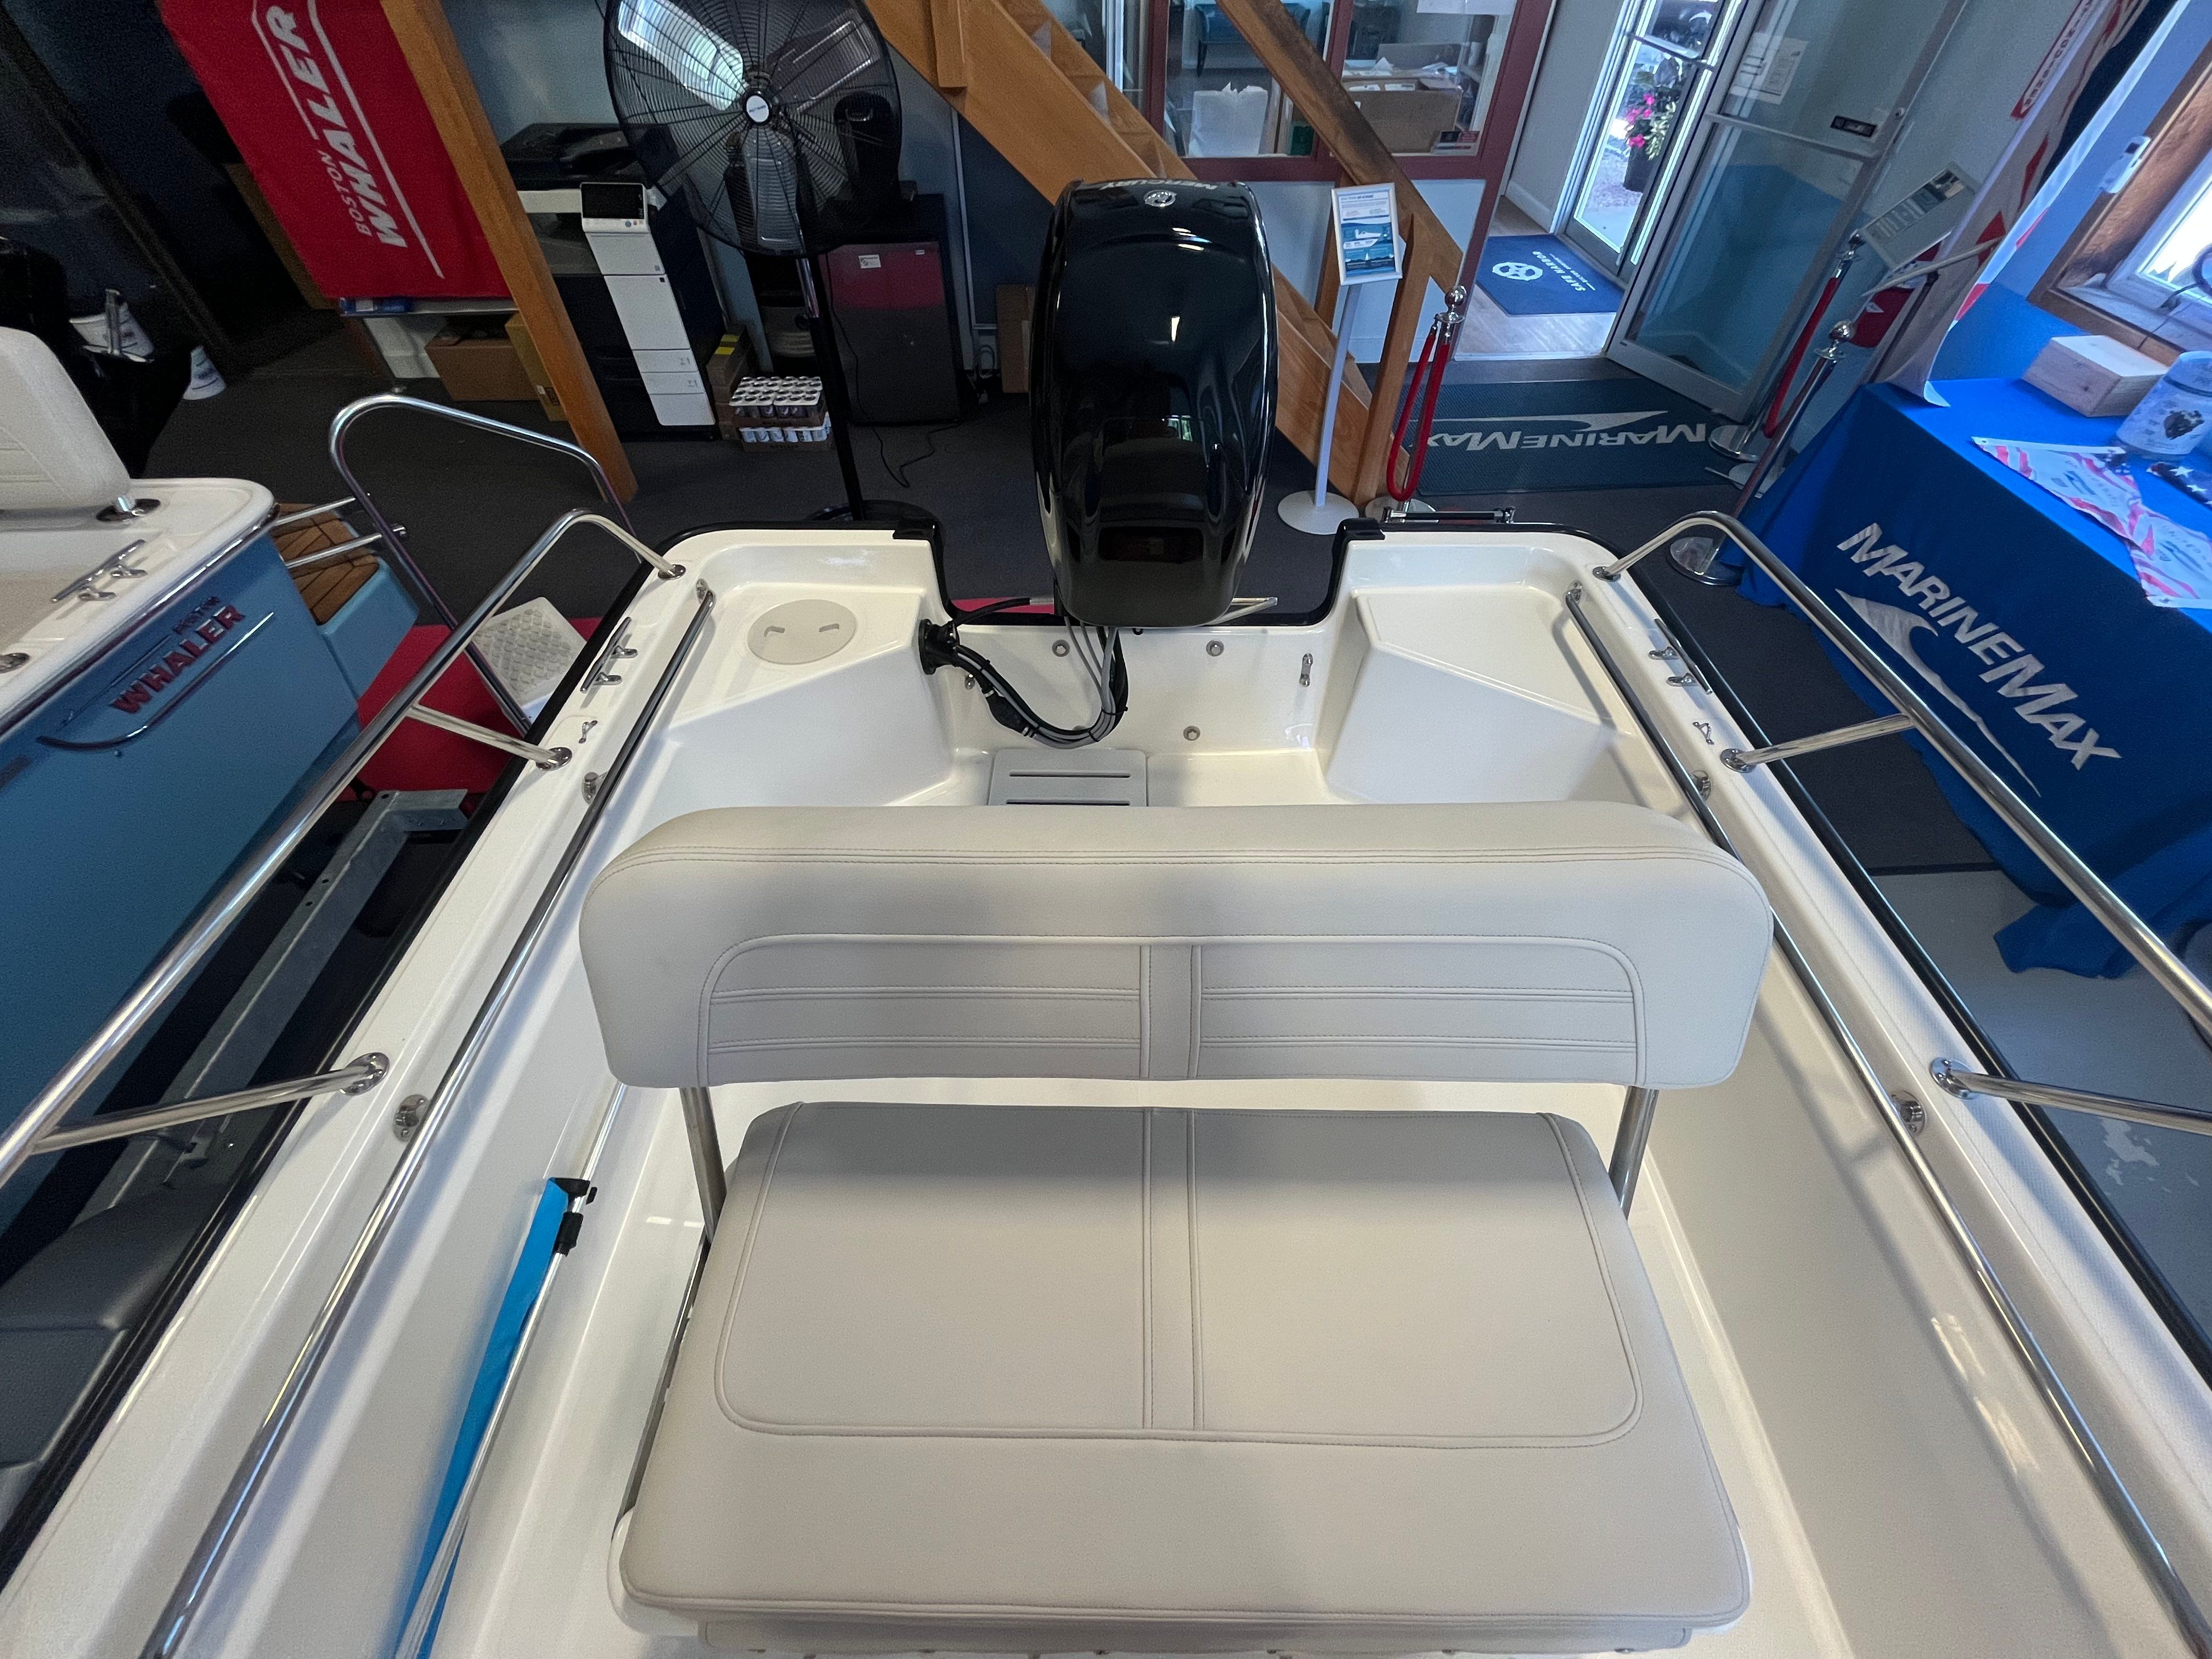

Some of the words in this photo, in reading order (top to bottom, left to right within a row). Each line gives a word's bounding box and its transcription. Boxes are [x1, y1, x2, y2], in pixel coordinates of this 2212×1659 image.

[266, 5, 408, 248] WHALER
[317, 150, 373, 237] BOSTON
[109, 605, 246, 714] WHALER
